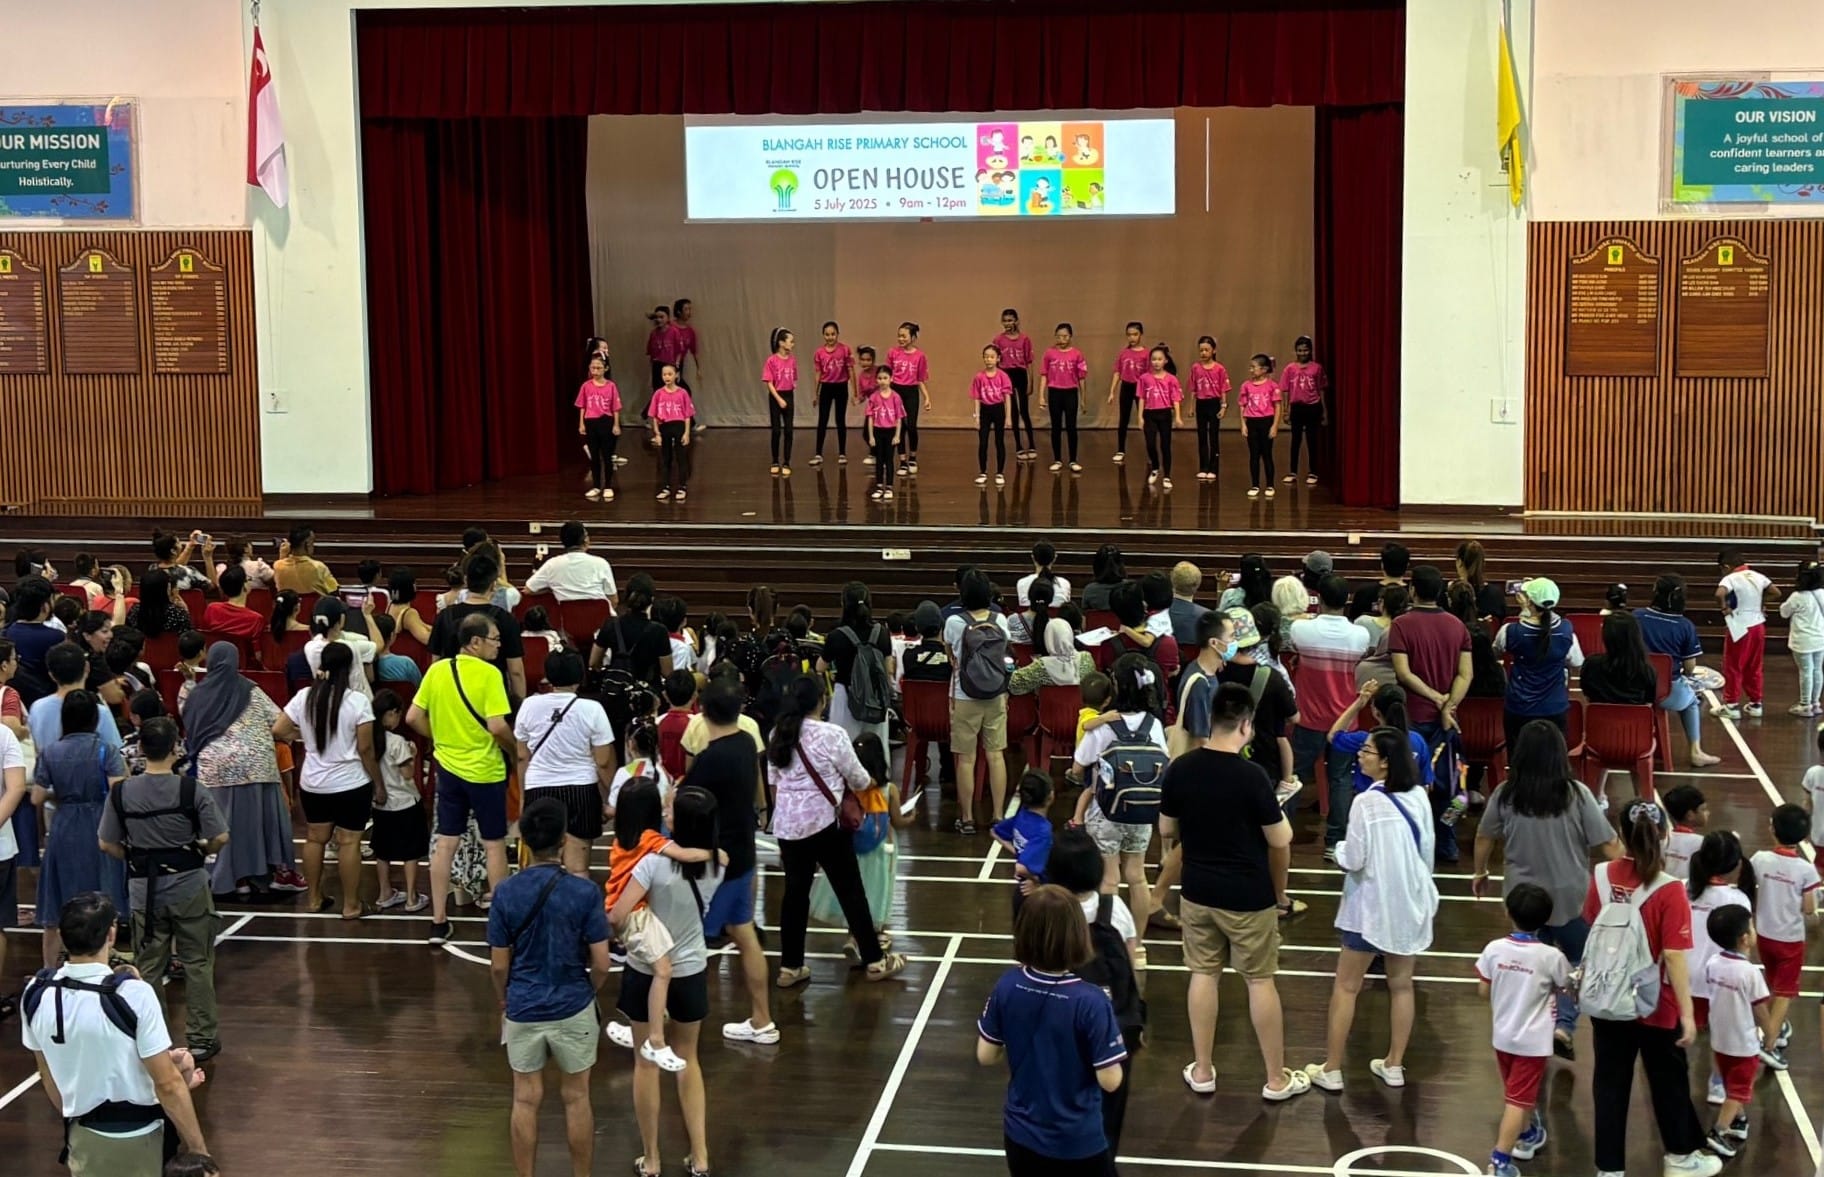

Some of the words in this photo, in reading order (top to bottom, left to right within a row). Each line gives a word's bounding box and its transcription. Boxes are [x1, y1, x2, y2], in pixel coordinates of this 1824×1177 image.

[1735, 111, 1764, 123] OUR
[1769, 111, 1816, 122] VISION
[0, 135, 25, 150] UR
[30, 134, 100, 149] MISSION
[763, 139, 823, 151] BLANGAH
[828, 138, 852, 150] RISE
[857, 137, 909, 150] PRIMARY
[913, 136, 968, 149] SCHOOL
[1723, 134, 1732, 144] A
[1736, 133, 1768, 145] joyful
[1771, 133, 1808, 143] school
[1811, 132, 1823, 142] of
[1710, 148, 1762, 158] confident
[1766, 148, 1812, 158] learners
[0, 160, 40, 171] urturing
[42, 160, 69, 171] Every
[71, 160, 96, 169] Child
[1734, 163, 1769, 174] caring
[1773, 162, 1814, 172] leaders
[19, 177, 74, 188] Holistically.
[813, 167, 878, 191] OPEN
[886, 166, 965, 190] HOUSE
[814, 199, 821, 210] 5
[824, 198, 846, 212] July
[849, 199, 877, 209] 2025
[899, 197, 924, 208] 9am
[936, 196, 967, 210] 12pm
